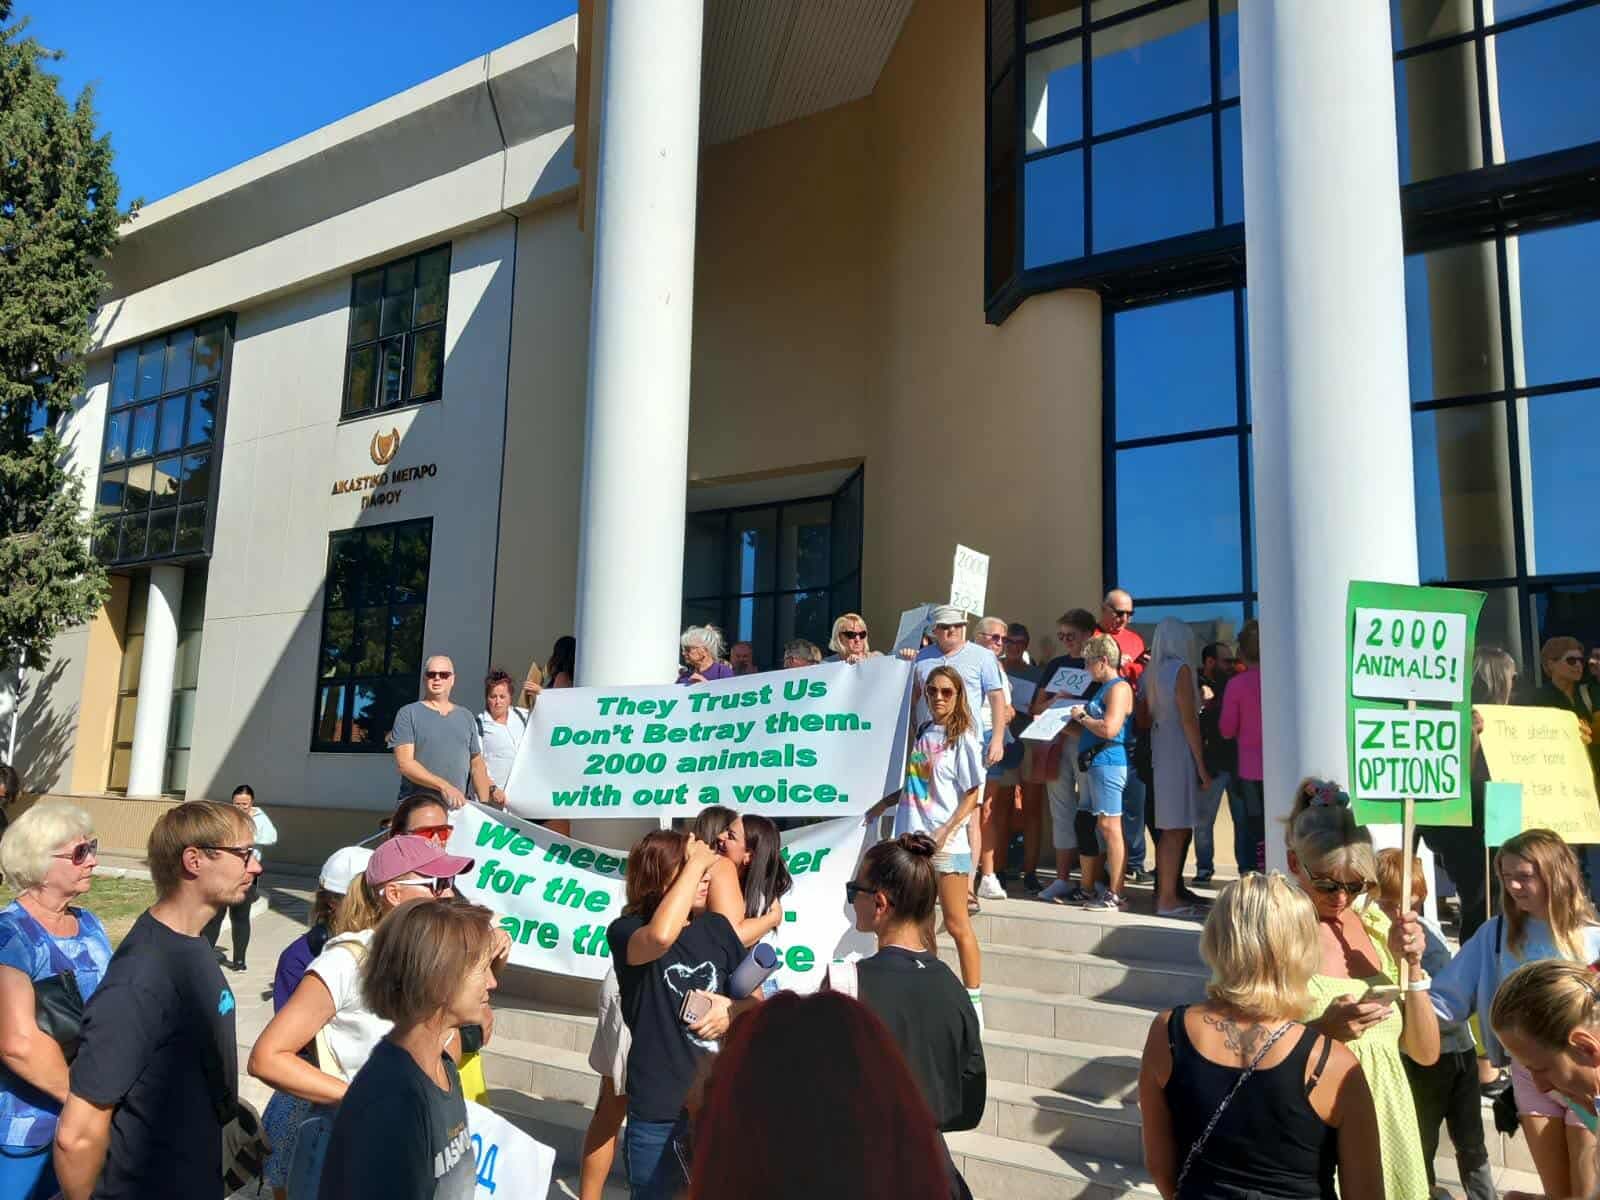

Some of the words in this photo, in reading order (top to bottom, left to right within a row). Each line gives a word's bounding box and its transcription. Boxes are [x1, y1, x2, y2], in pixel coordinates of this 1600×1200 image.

[331, 472, 388, 495] ΔΙΚΑΣΤΙΚΟ
[392, 463, 437, 483] ΜΕΓΑΡΟ
[361, 490, 401, 509] ΠΑΦΟΥ
[1366, 618, 1447, 650] 2000
[1355, 654, 1457, 683] ANIMALS!
[597, 696, 679, 719] They
[688, 685, 773, 712] Trust
[783, 678, 827, 701] Us
[550, 724, 632, 747] Don't
[643, 716, 756, 745] Betray
[765, 711, 872, 734] them.
[1358, 720, 1457, 751] ZERO
[583, 753, 667, 775] 2000
[676, 743, 817, 773] animals
[1359, 754, 1458, 793] OPTIONS
[552, 783, 621, 807] with
[633, 784, 688, 806] out
[698, 786, 720, 804] a
[732, 779, 849, 804] voice.
[475, 821, 535, 856] We
[476, 859, 536, 895] for
[542, 876, 611, 912] the
